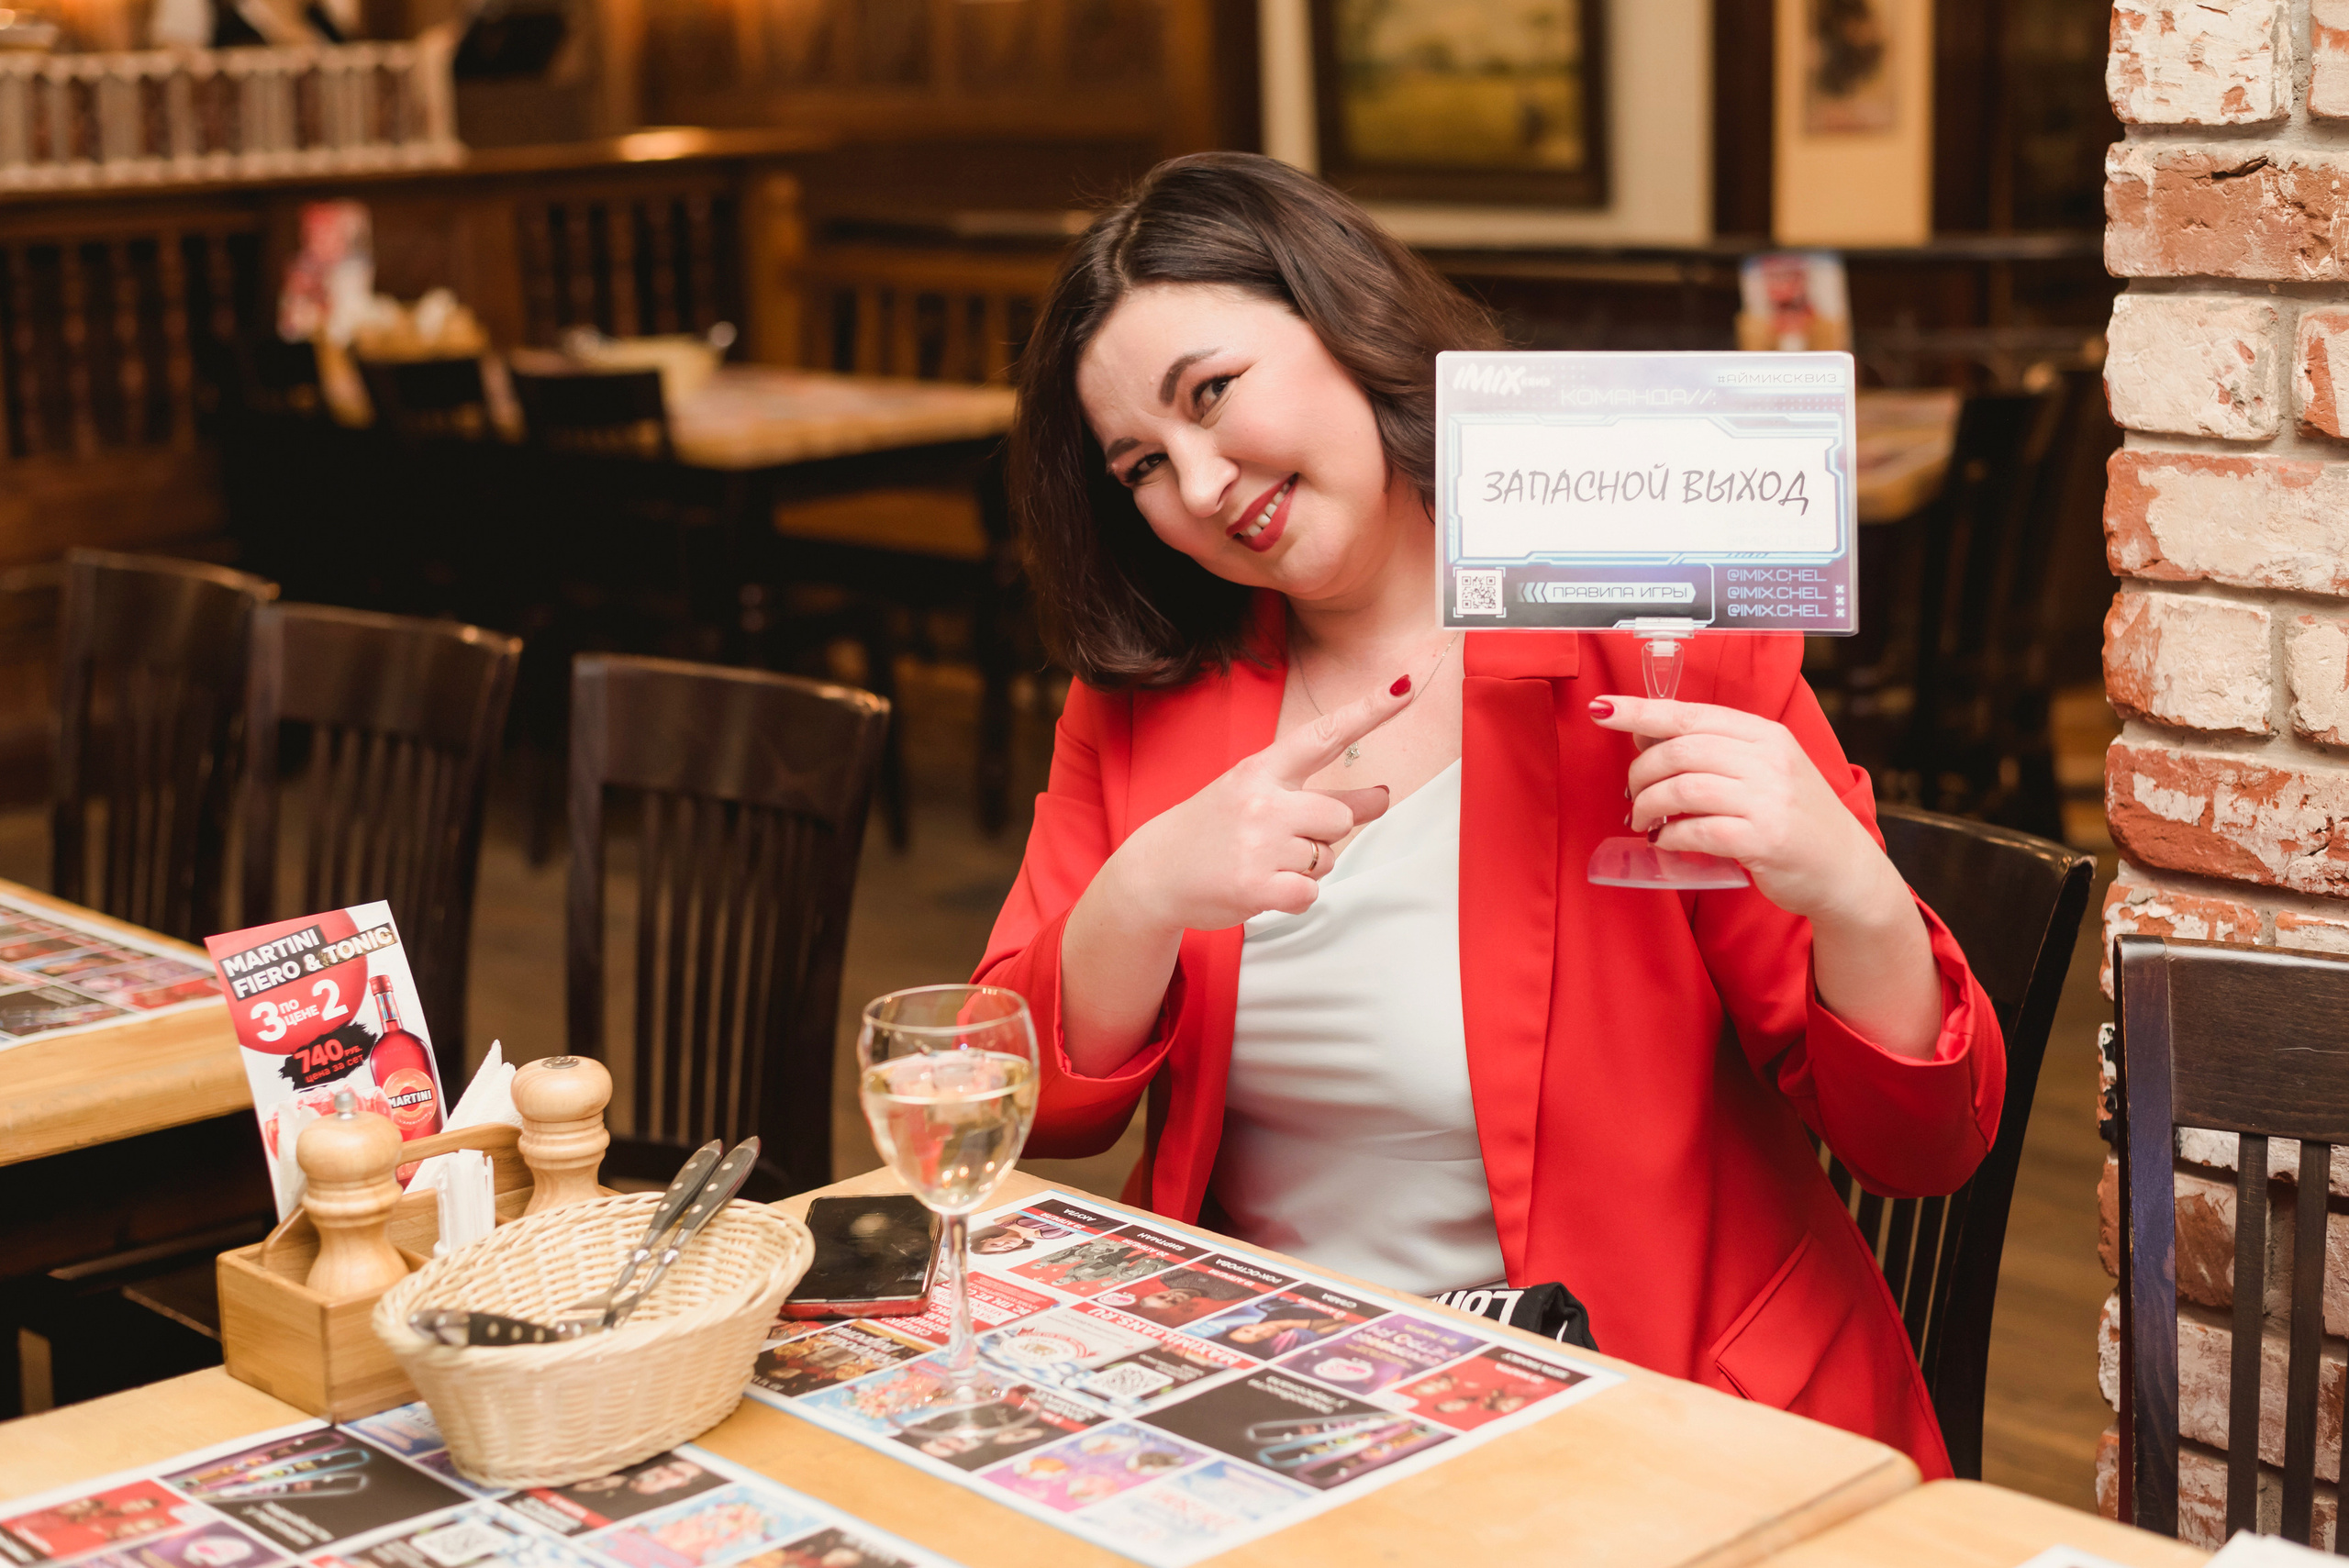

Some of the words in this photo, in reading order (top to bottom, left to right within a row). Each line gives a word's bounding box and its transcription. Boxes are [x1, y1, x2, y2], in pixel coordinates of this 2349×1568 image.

[1717, 372, 1837, 384] #АЙМИКСКВИЗ
[1482, 462, 1670, 506] ЗАПАСНОЙ
[1682, 468, 1809, 516] ВЫХОД
[1727, 569, 1828, 582] @IMIX.CHEL
[1553, 586, 1634, 598] ПРАВИЛА
[1640, 586, 1688, 598] ИГРЫ
[1727, 586, 1828, 599] @IMIX.CHEL
[1728, 604, 1829, 617] @IMIX.CHEL
[222, 929, 320, 978] MARTINI
[230, 961, 301, 999] FIERO
[303, 953, 324, 973] &
[322, 927, 393, 964] TONIC
[278, 998, 300, 1015] ПО
[311, 979, 349, 1022] 2
[250, 1000, 287, 1042] 3
[283, 1004, 320, 1026] ЦЕНЕ
[293, 1039, 344, 1073] 740
[1040, 1212, 1075, 1227] АПРЕЛЯ
[1063, 1208, 1097, 1222] АКУЛА
[1121, 1239, 1158, 1254] АПРЕЛЯ
[1137, 1232, 1186, 1251] БИРТМАН
[1087, 1307, 1242, 1365] MAXIMILIANS.RU
